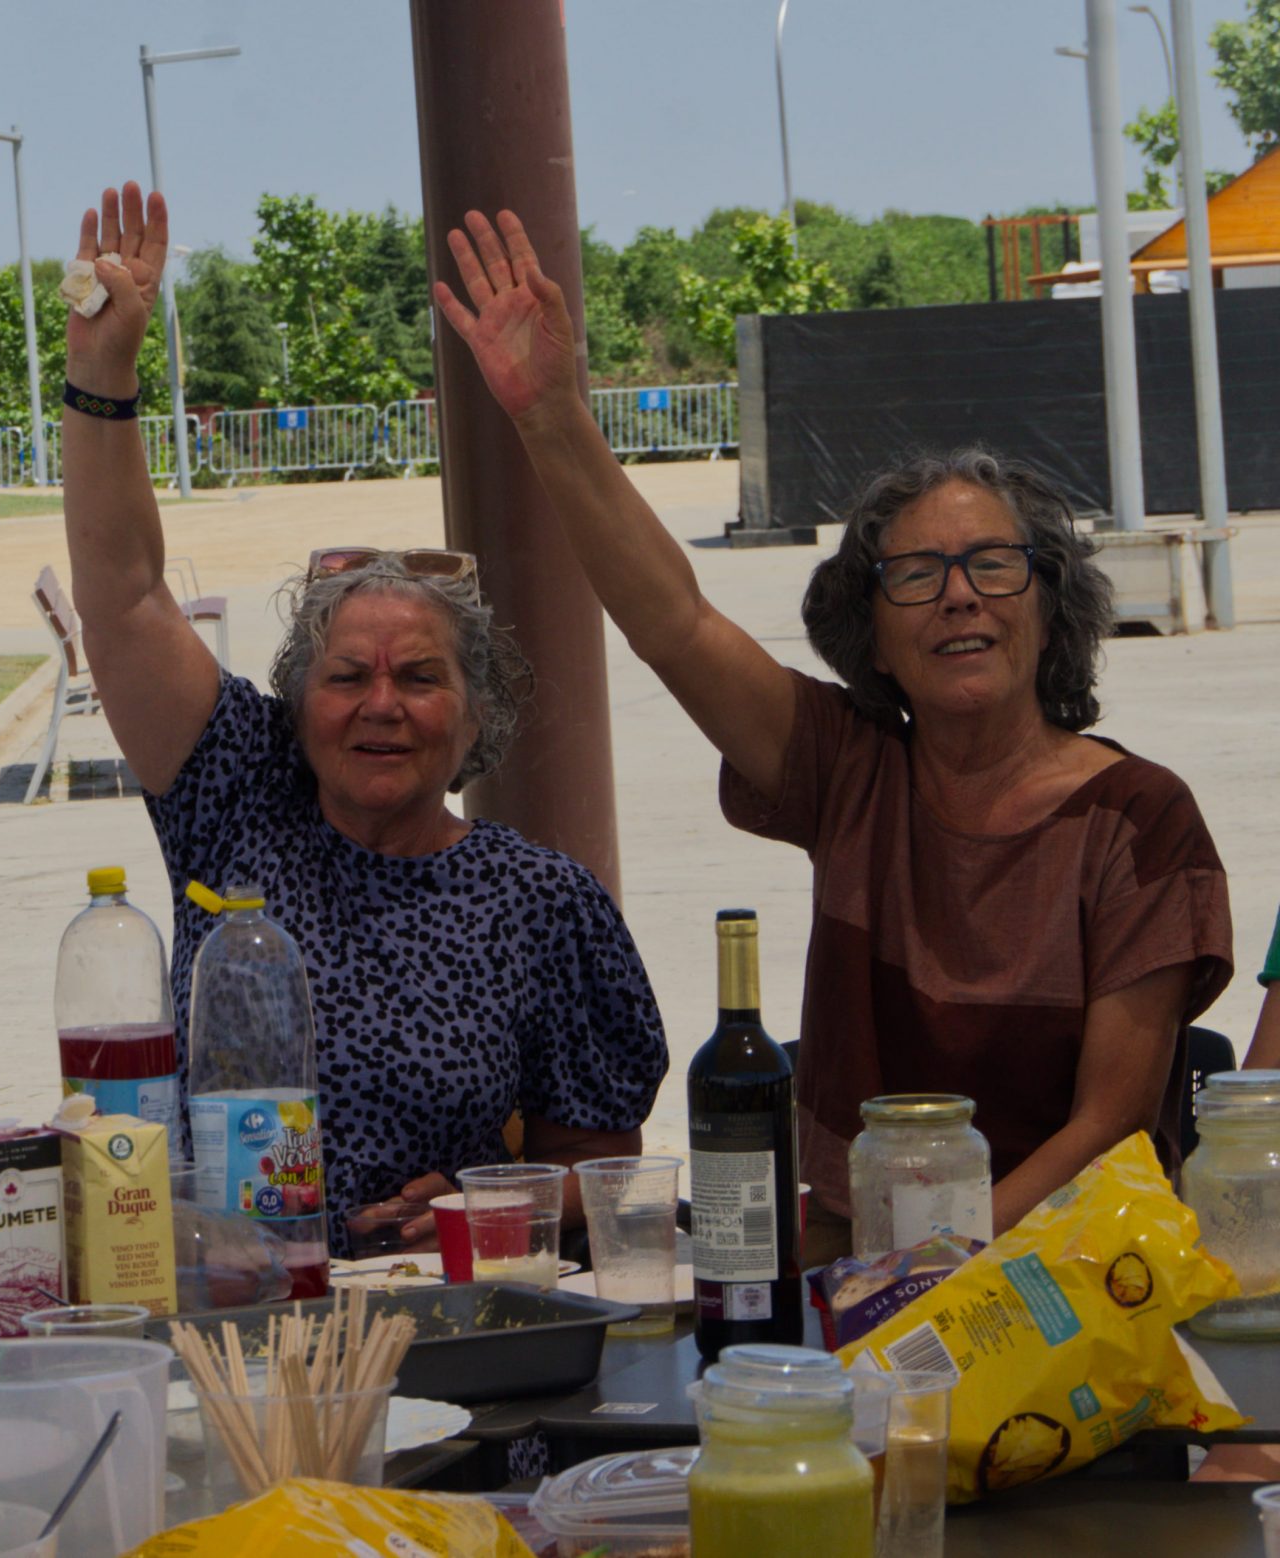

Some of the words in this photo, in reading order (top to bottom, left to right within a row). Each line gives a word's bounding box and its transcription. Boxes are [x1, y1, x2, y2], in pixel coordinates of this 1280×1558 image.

[272, 1145, 318, 1168] Vera
[268, 1170, 299, 1186] con
[113, 1186, 151, 1201] Gran
[262, 1195, 277, 1207] 0,0
[107, 1200, 157, 1216] Duque
[110, 1244, 134, 1253] VINO
[135, 1242, 160, 1251] TINTO
[116, 1253, 134, 1261] RED
[135, 1251, 155, 1260] WINE
[115, 1262, 131, 1270] VIN
[132, 1260, 159, 1269] ROUGE
[116, 1271, 139, 1280] WEIN
[141, 1269, 157, 1277] ROT
[108, 1279, 139, 1289] VINHO
[140, 1276, 166, 1286] TINTO
[895, 1275, 945, 1298] ANOS
